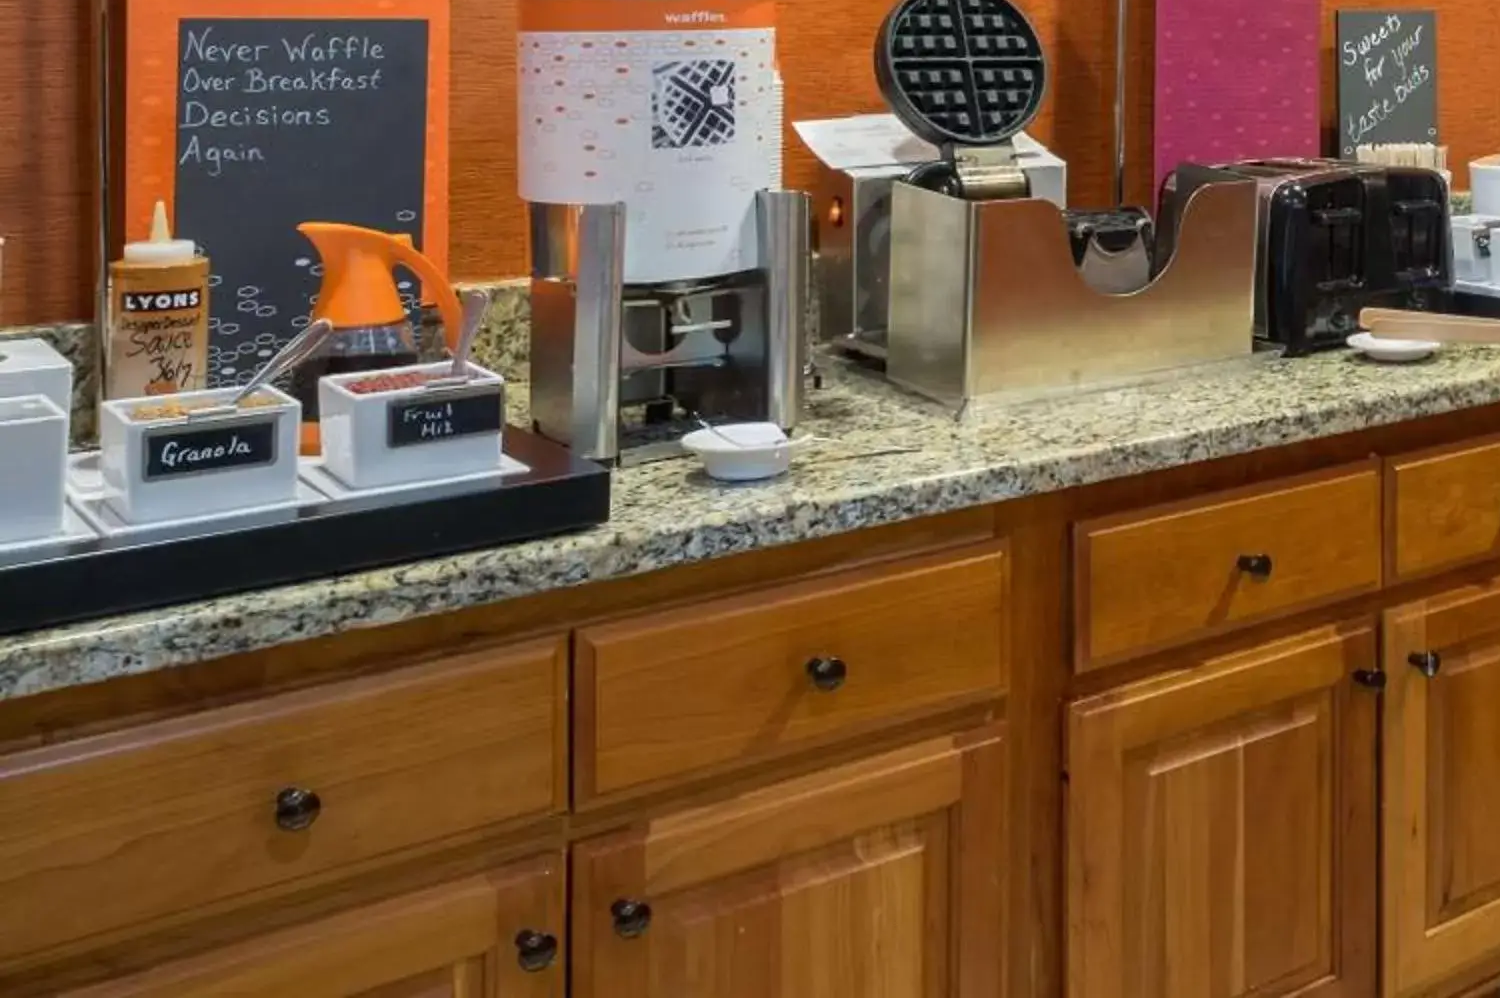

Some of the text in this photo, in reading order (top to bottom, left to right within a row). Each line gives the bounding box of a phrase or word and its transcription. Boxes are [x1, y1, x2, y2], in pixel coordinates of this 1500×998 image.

[183, 26, 385, 63] Never Waffle
[1343, 13, 1401, 66] Sweets
[1364, 25, 1423, 88] for your
[183, 66, 383, 93] Over Breakfast
[179, 100, 332, 130] Decisions
[179, 134, 265, 177] Again
[124, 290, 200, 310] LYONS
[160, 438, 252, 467] Granola
